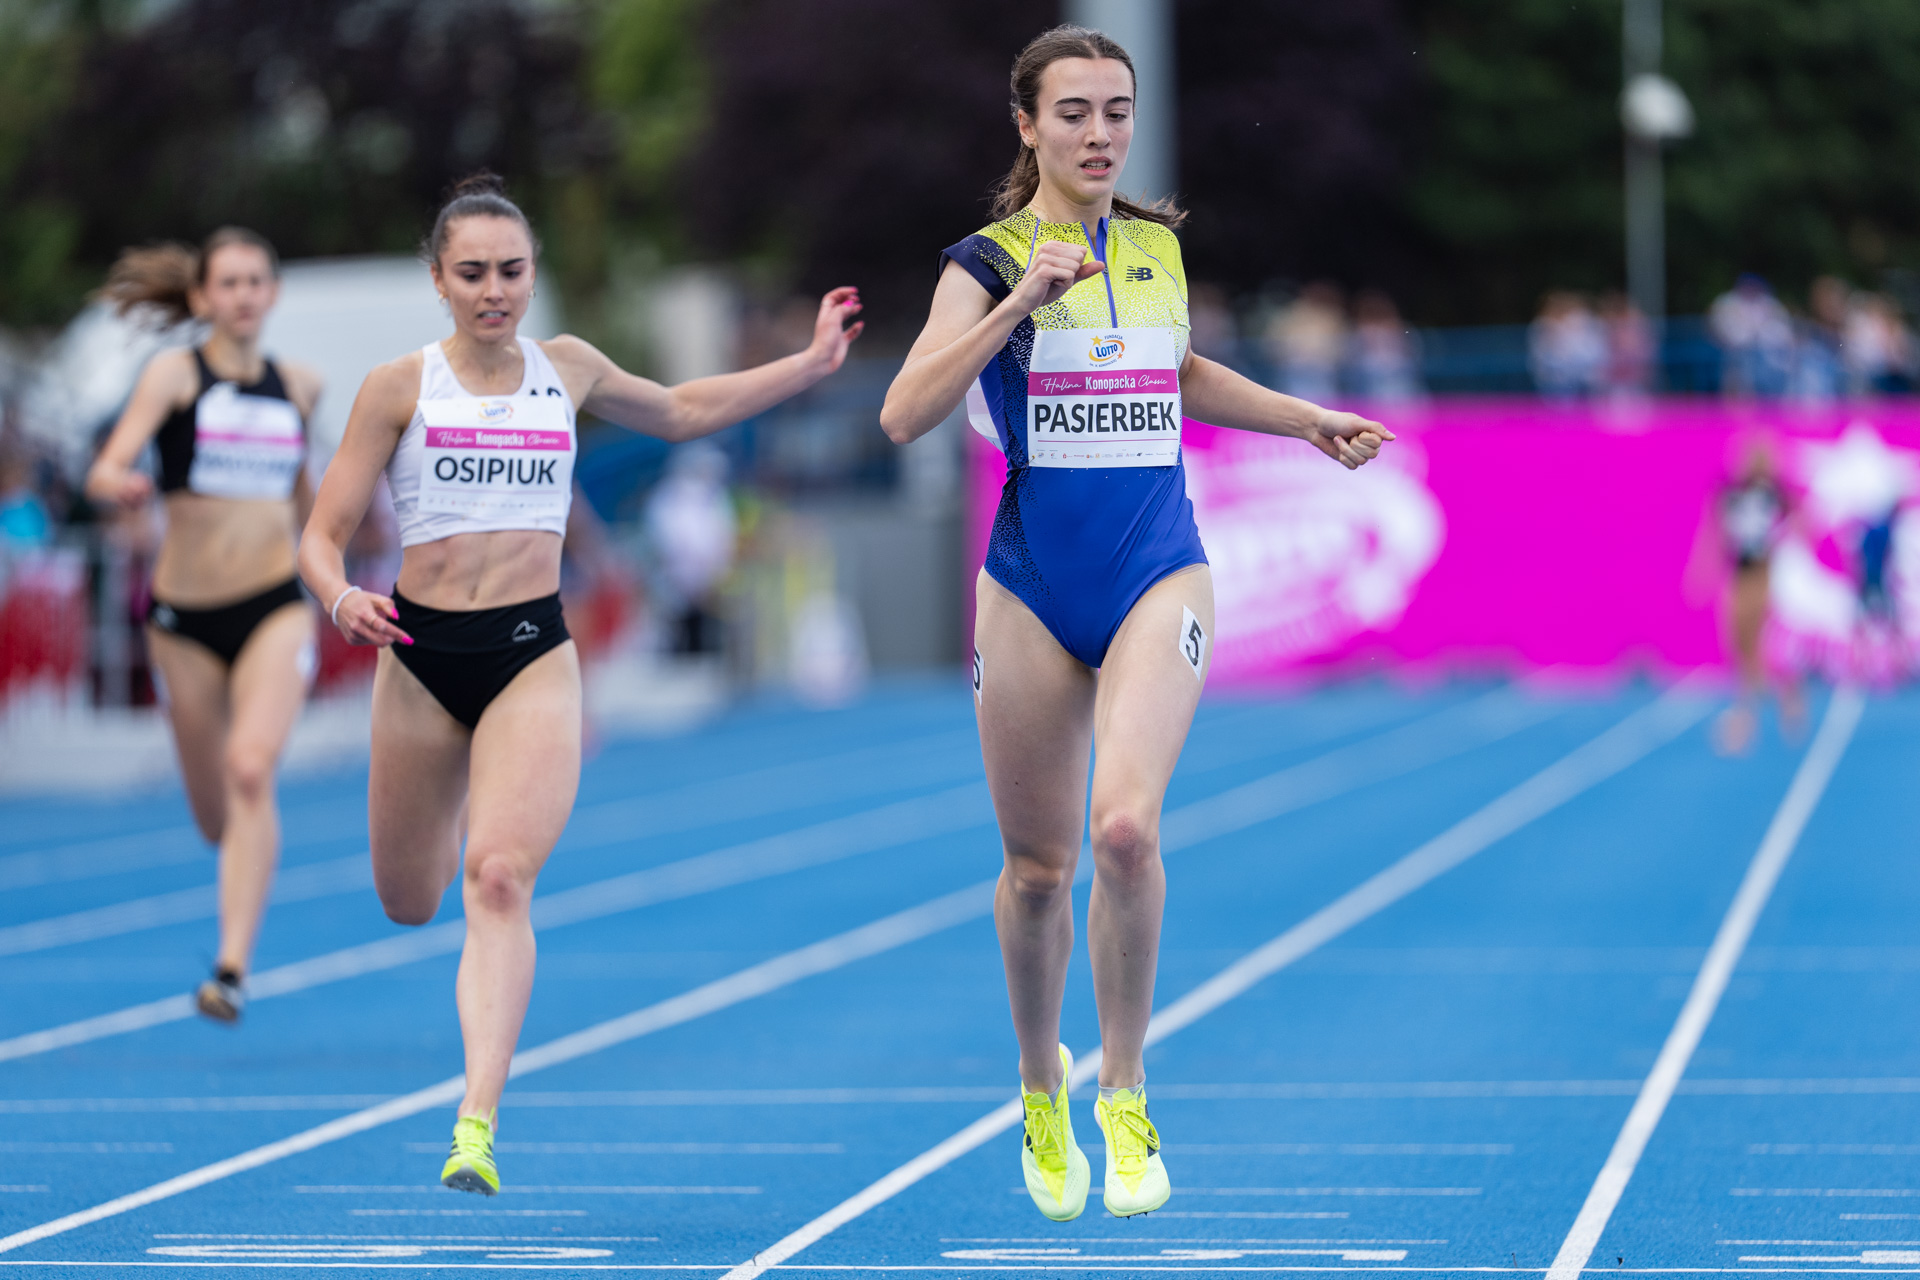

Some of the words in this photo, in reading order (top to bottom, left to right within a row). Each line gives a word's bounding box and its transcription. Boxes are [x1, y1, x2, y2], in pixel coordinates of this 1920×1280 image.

[1095, 343, 1118, 358] LOTTO
[1041, 377, 1082, 394] Halina
[1085, 375, 1136, 392] Konopacka
[1137, 374, 1168, 388] Classic
[1034, 401, 1177, 433] PASIERBEK
[475, 431, 525, 448] Konopacka
[434, 456, 557, 485] OSIPIUK
[1185, 618, 1202, 667] 5
